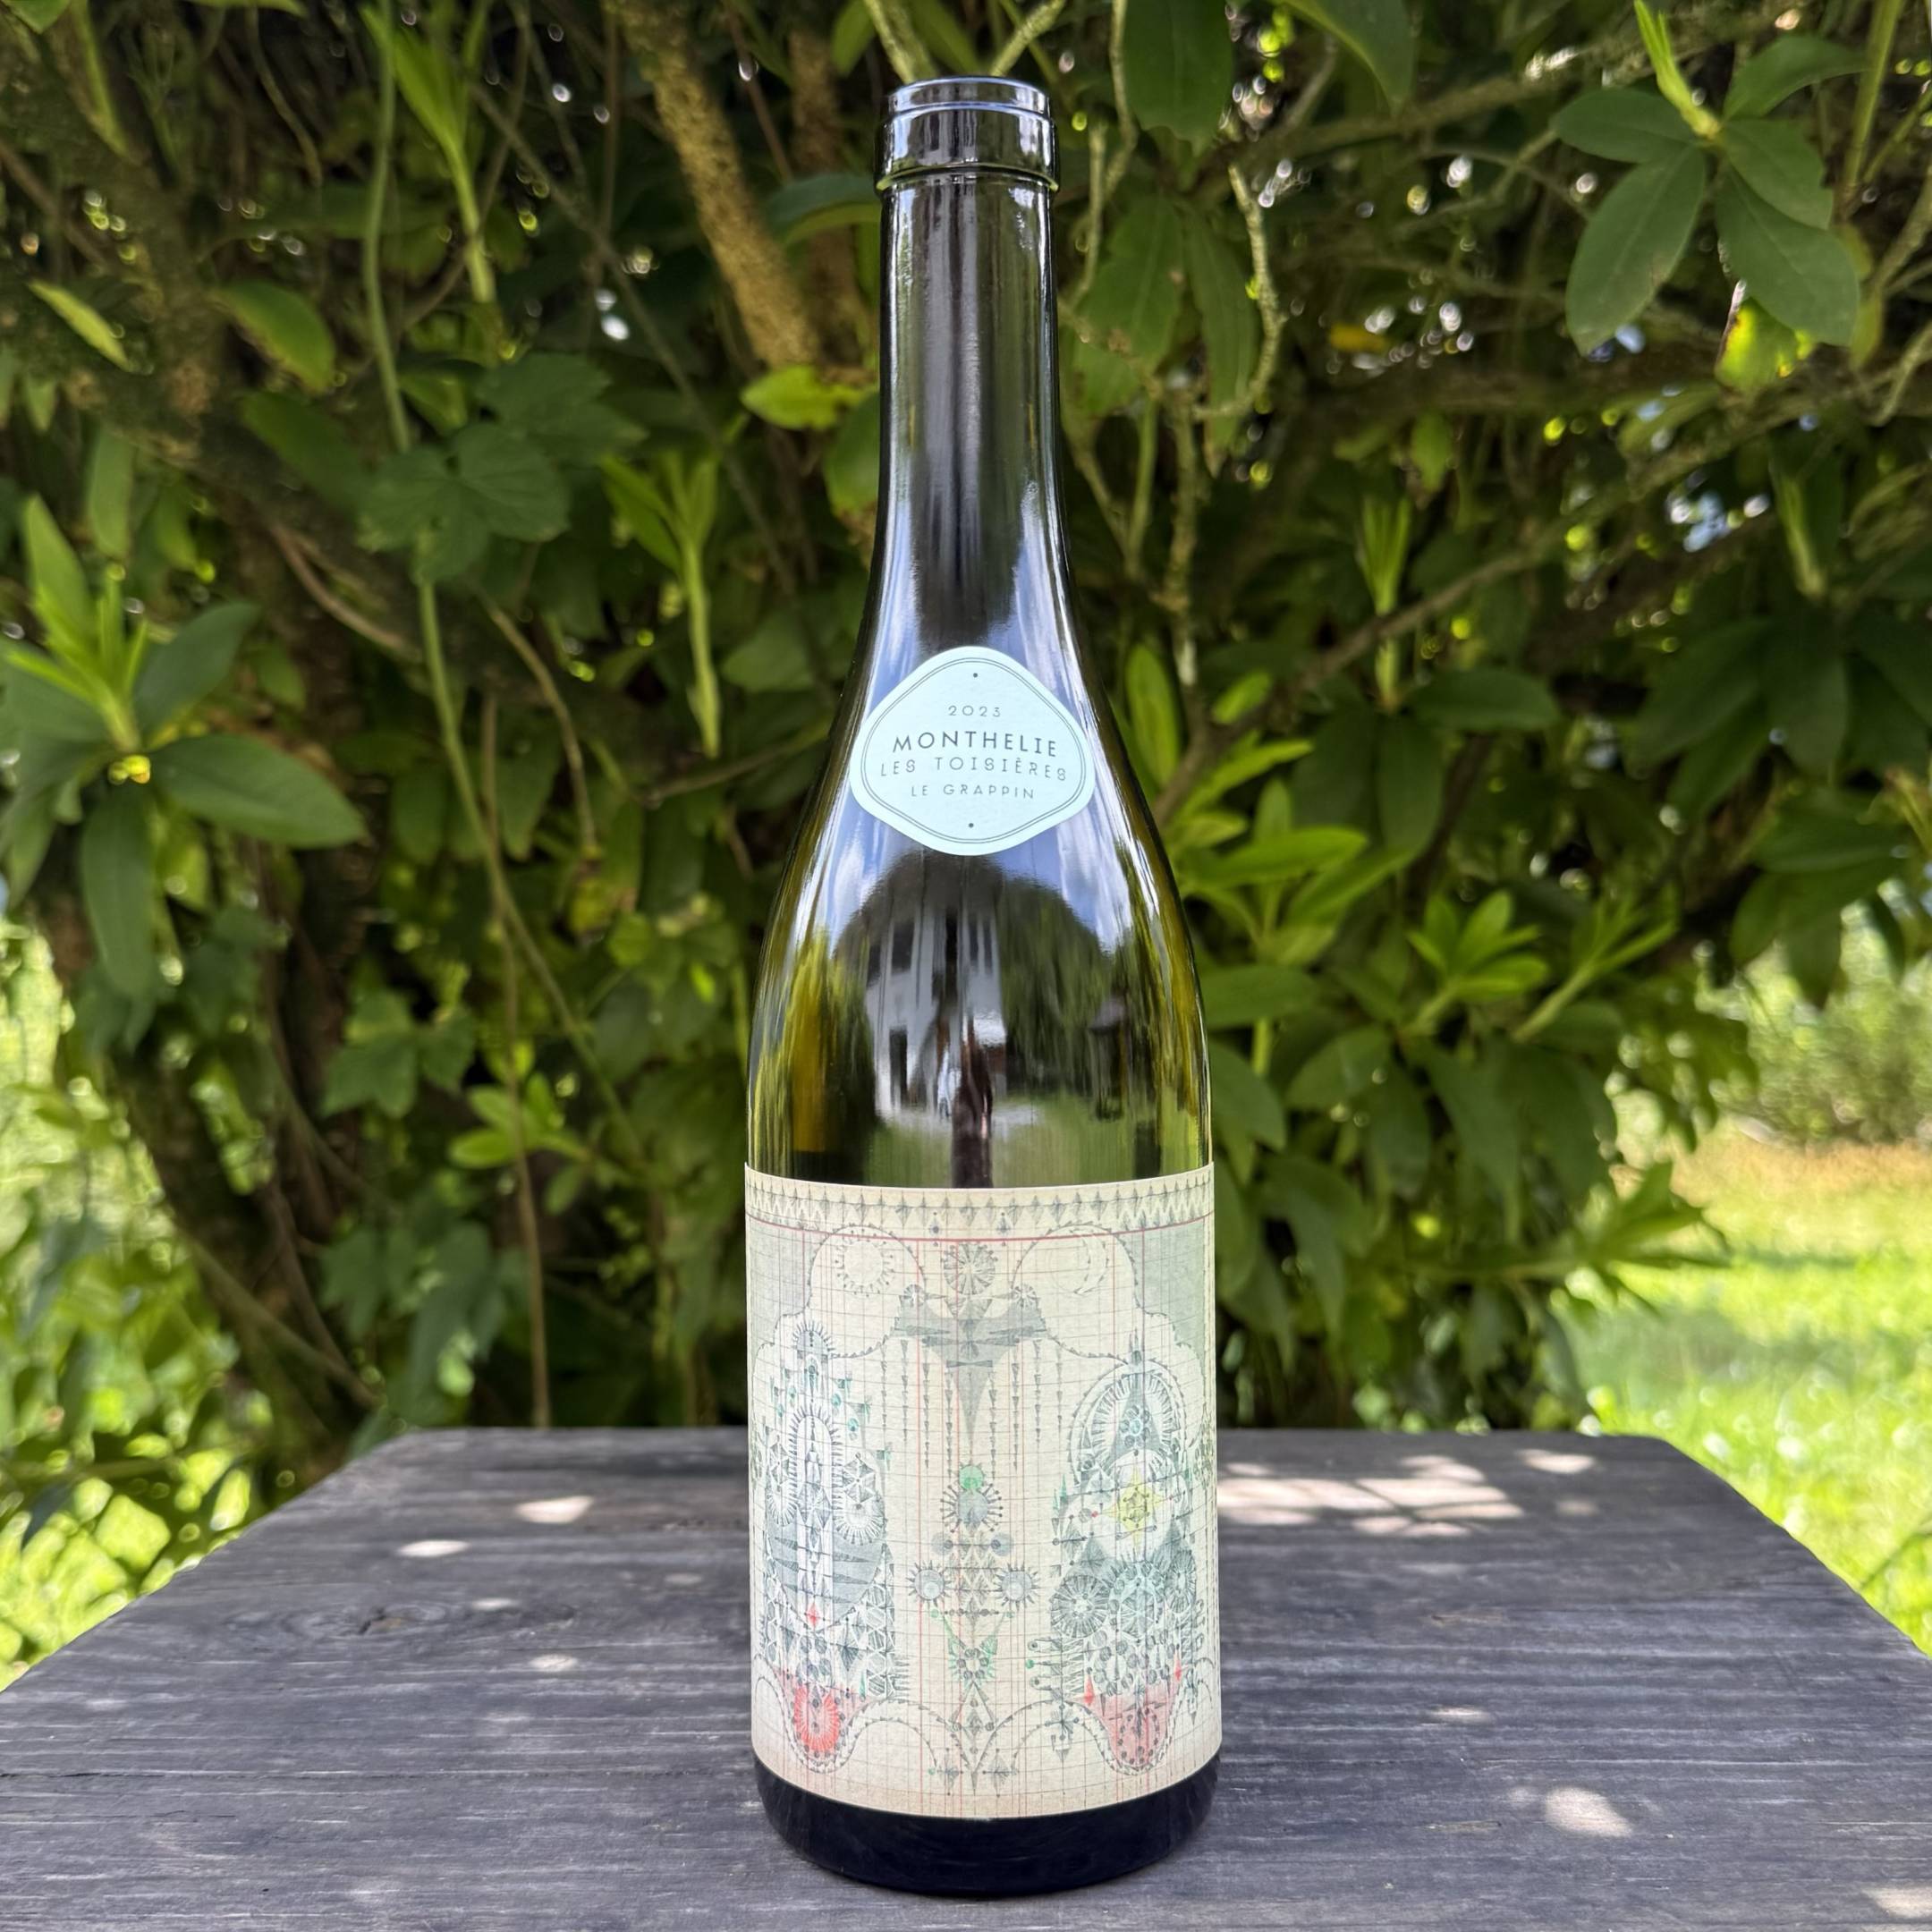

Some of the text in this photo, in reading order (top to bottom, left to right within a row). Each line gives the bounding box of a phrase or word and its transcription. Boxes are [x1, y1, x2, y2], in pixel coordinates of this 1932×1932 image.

[947, 705, 1001, 717] 2023
[893, 731, 1056, 758] MONTHELIE
[880, 757, 1066, 781] LES TOISIÈRES
[911, 784, 1034, 799] LE GRAPPIN
